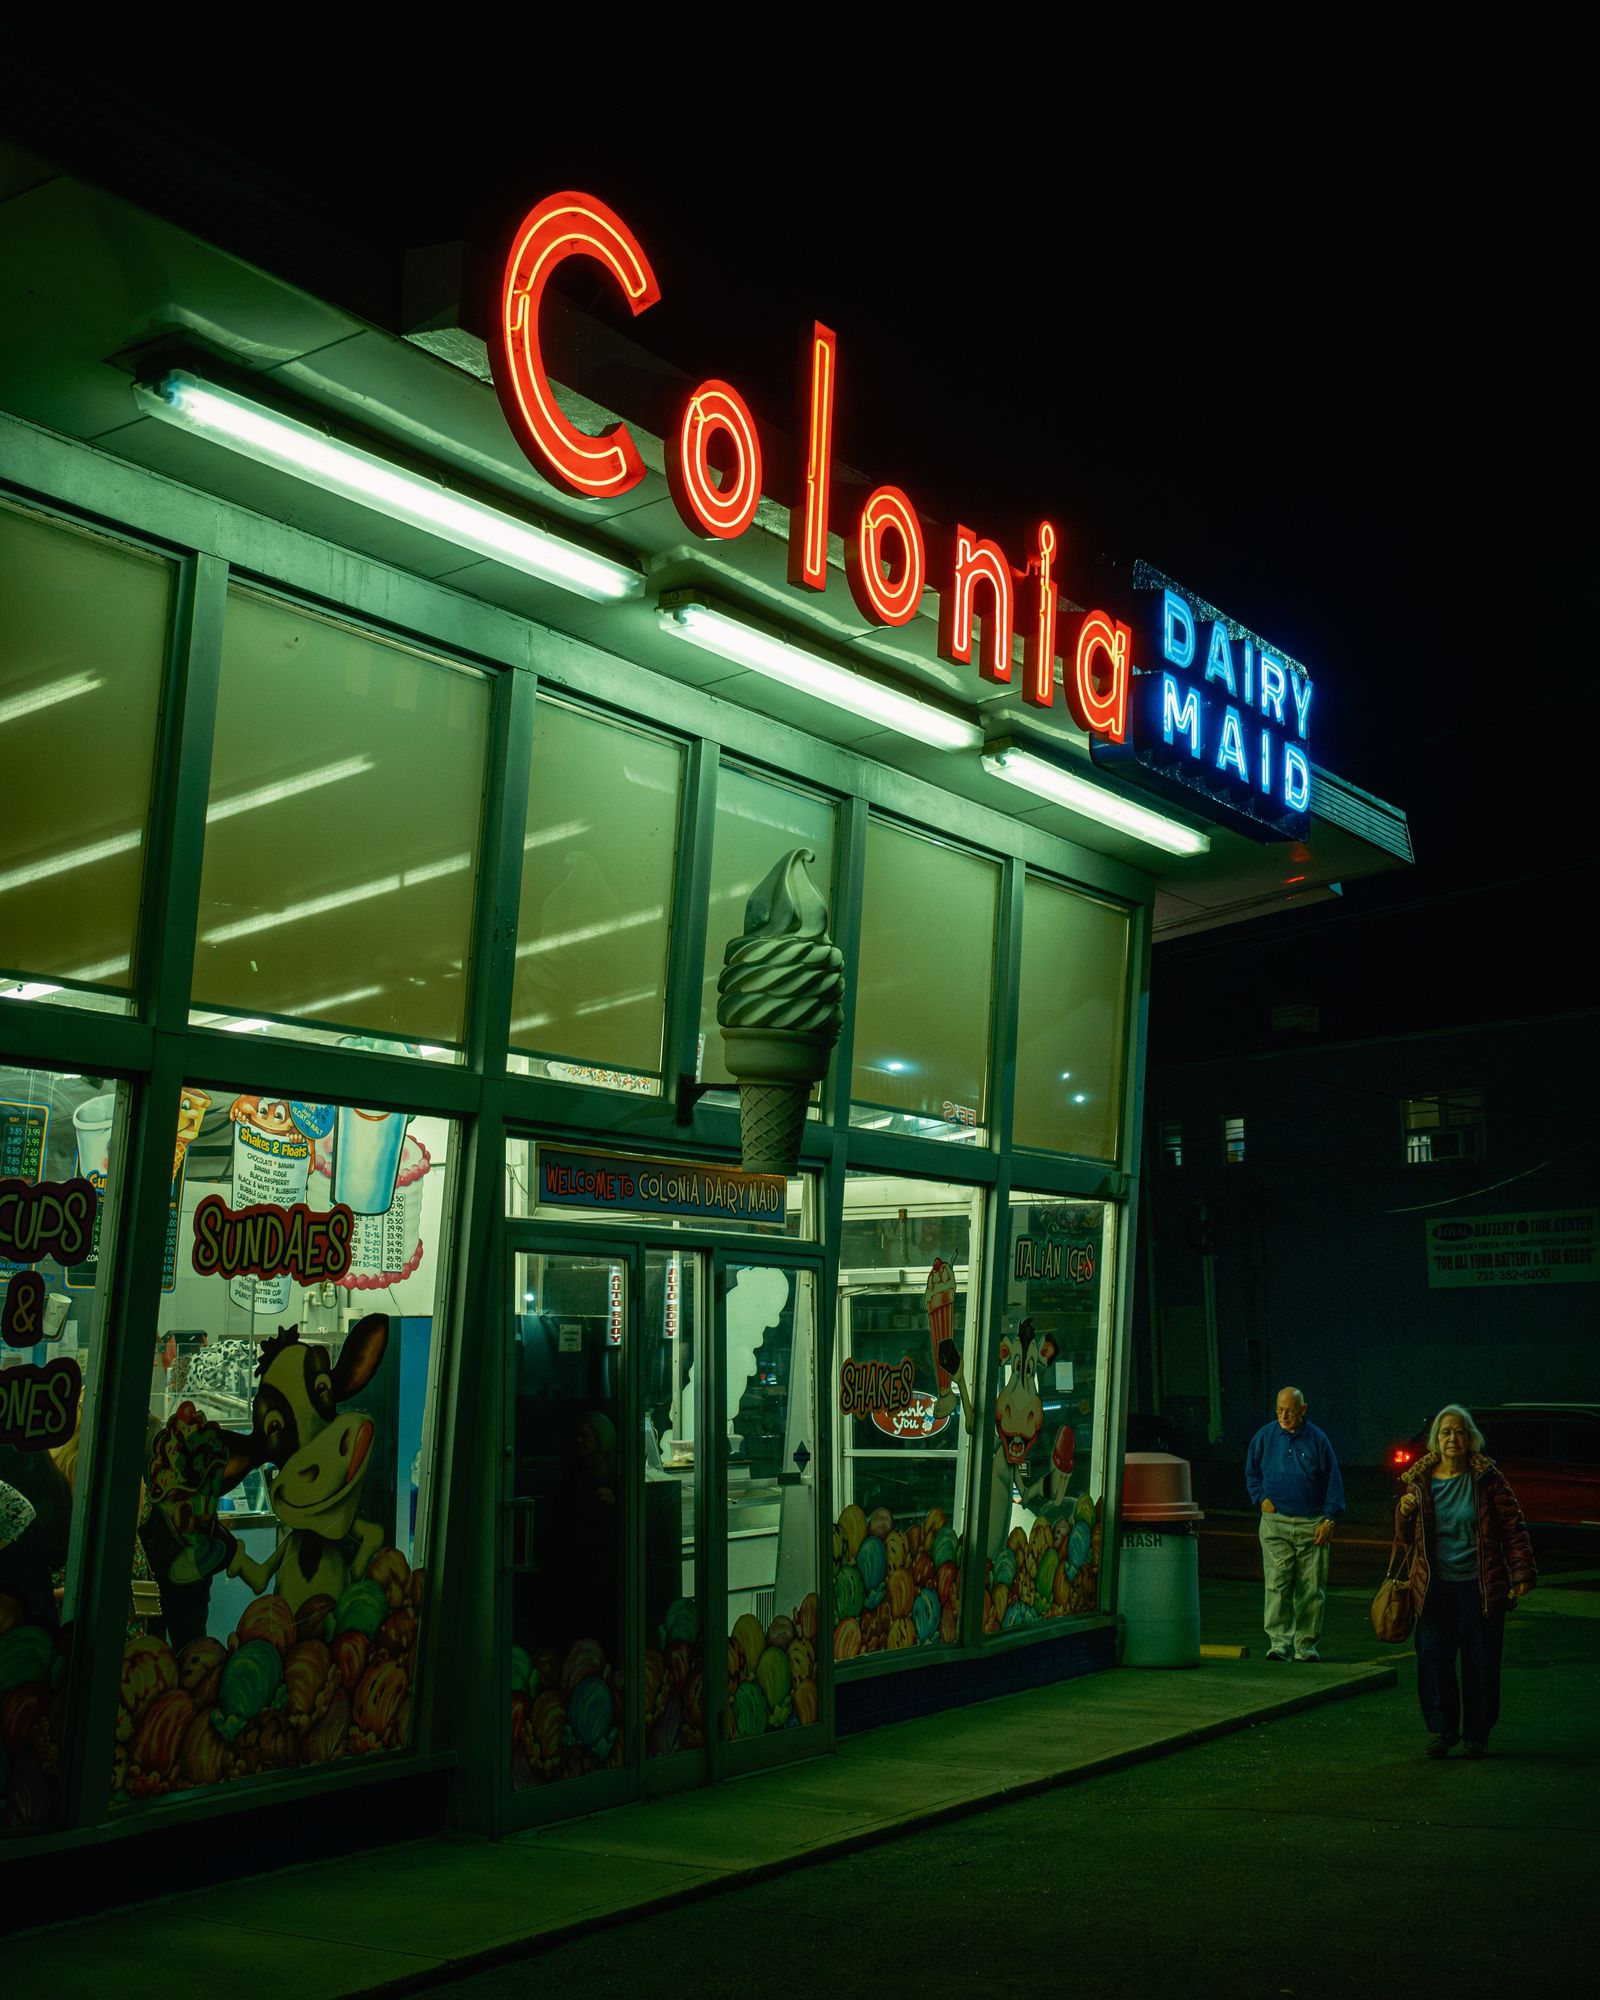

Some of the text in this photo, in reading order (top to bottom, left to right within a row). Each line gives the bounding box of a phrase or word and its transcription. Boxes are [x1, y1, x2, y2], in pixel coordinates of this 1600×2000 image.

[500, 190, 1131, 744] Colonia
[1164, 589, 1313, 739] DAIRY
[1163, 672, 1310, 813] MAID
[241, 1128, 307, 1158] Shakes & Floats
[247, 1152, 273, 1167] CHOCOLATE
[238, 1174, 253, 1186] BLACK
[250, 1171, 264, 1183] BLACK
[546, 1162, 615, 1200] WELCOME
[0, 1191, 87, 1253] CUPS
[1474, 1221, 1516, 1237] BATTERY
[198, 1206, 350, 1279] SUNDAES
[1065, 1243, 1095, 1284] ICES
[12, 1284, 37, 1333] &
[254, 1296, 267, 1304] UTTER
[842, 1363, 912, 1413] SHAKES
[893, 1417, 919, 1435] you
[1120, 1534, 1162, 1548] TRASH
